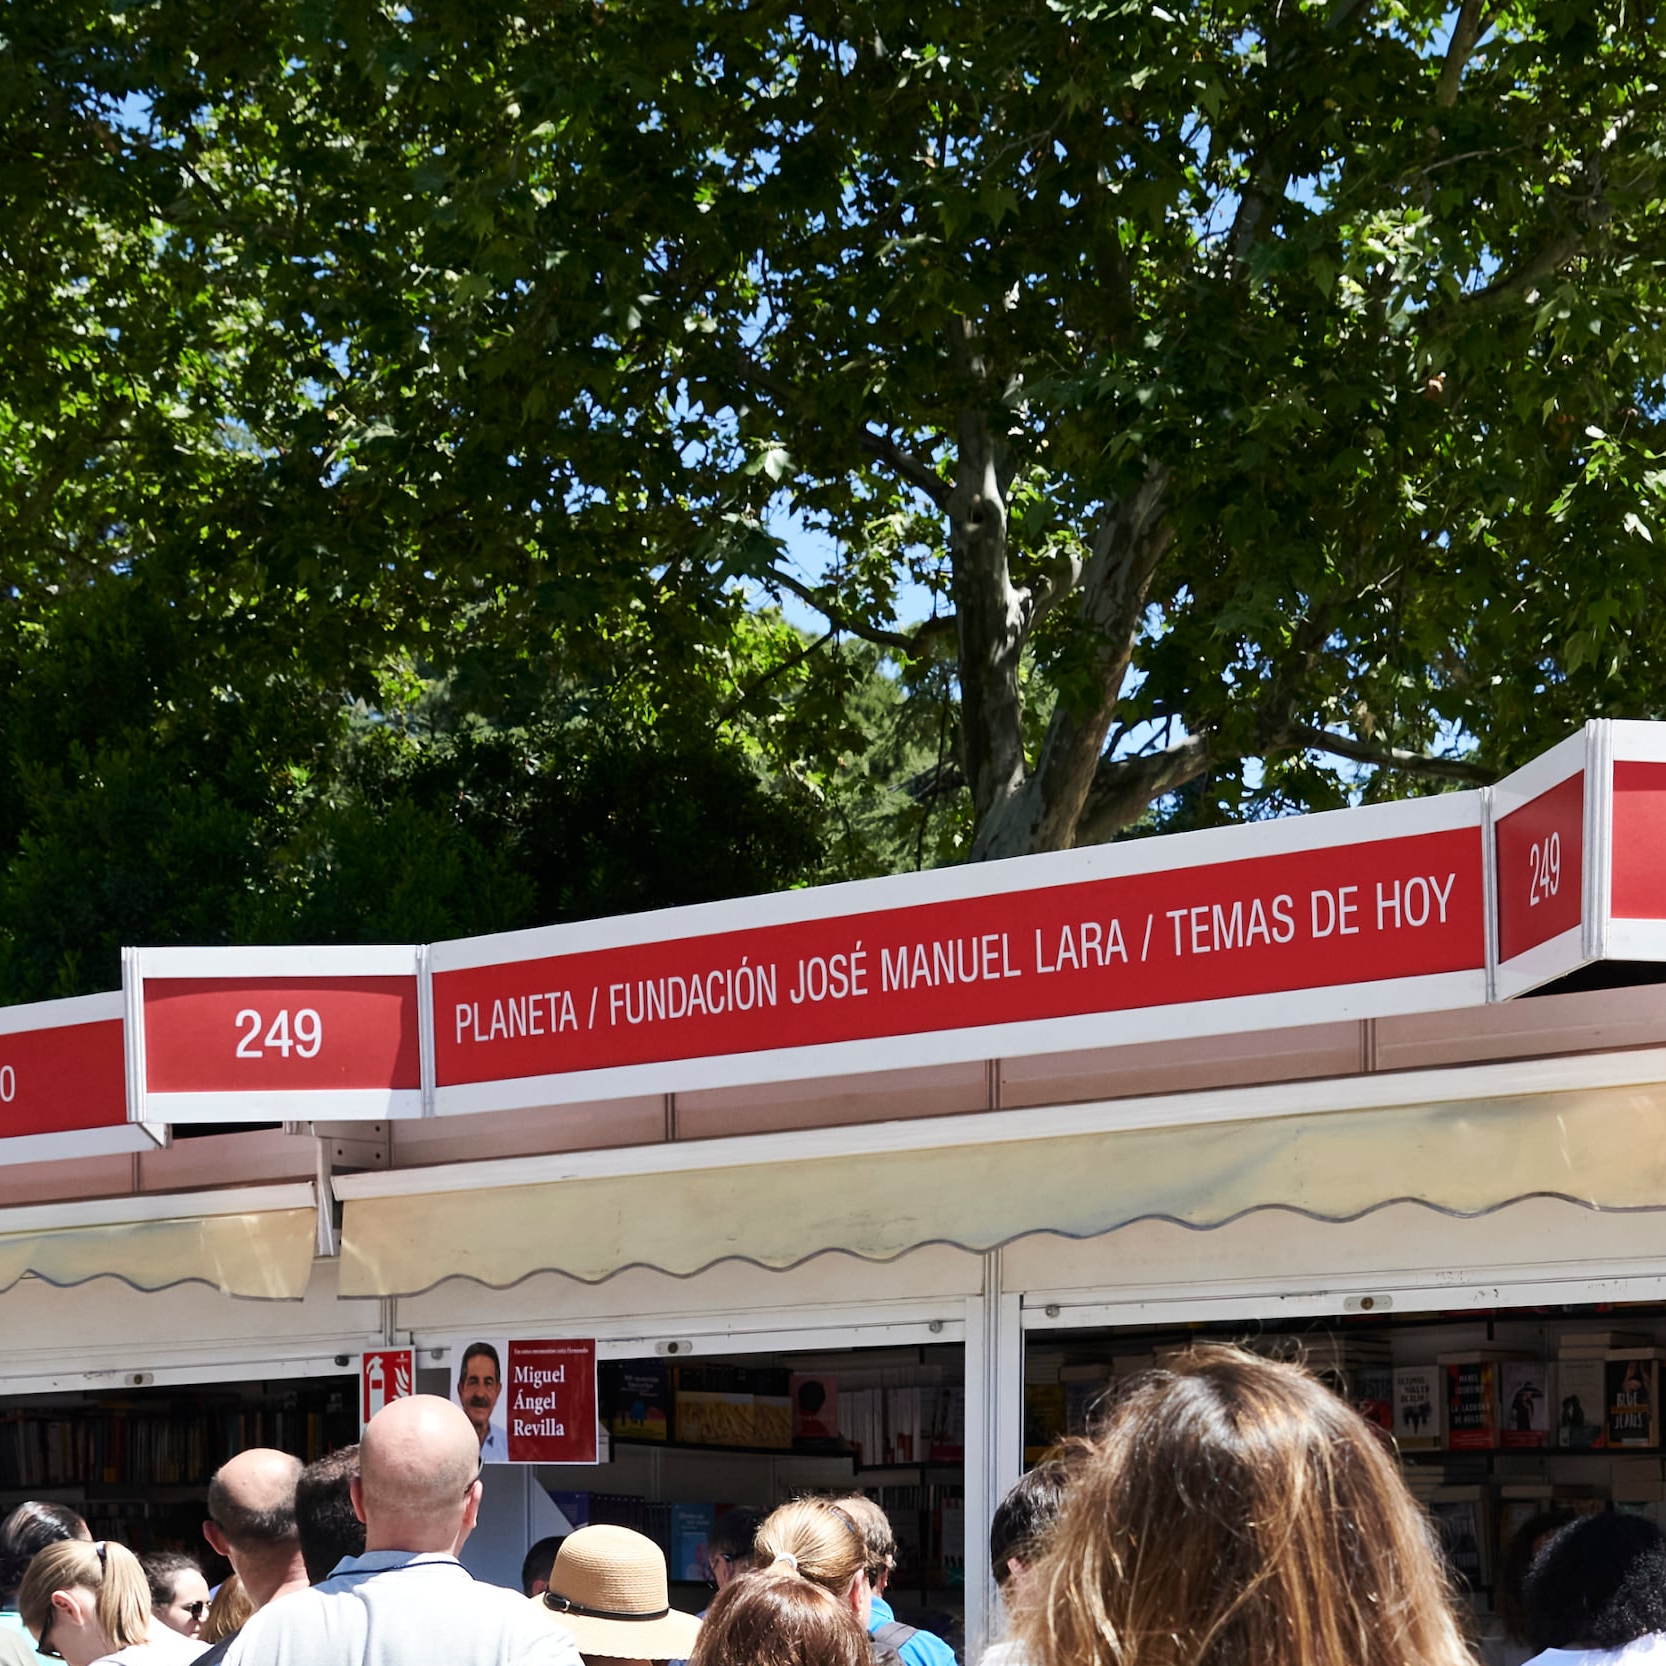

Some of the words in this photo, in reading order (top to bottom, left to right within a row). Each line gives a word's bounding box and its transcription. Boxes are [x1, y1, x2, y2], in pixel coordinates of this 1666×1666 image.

[1528, 831, 1562, 907] 249
[455, 991, 578, 1045] PLANETA
[587, 988, 599, 1029] /
[609, 956, 778, 1027] FUNDACIÓN
[789, 940, 868, 1007] JOSÉ
[881, 932, 1022, 992] MANUEL
[1035, 916, 1128, 975] LARA
[1141, 913, 1153, 962] /
[1165, 894, 1295, 956] TEMAS
[1310, 885, 1359, 939] DE
[1377, 872, 1457, 931] HOY
[234, 1008, 322, 1059] 249
[513, 1364, 565, 1388] Miguel
[513, 1391, 556, 1415] Ángel
[513, 1419, 565, 1437] Revilla
